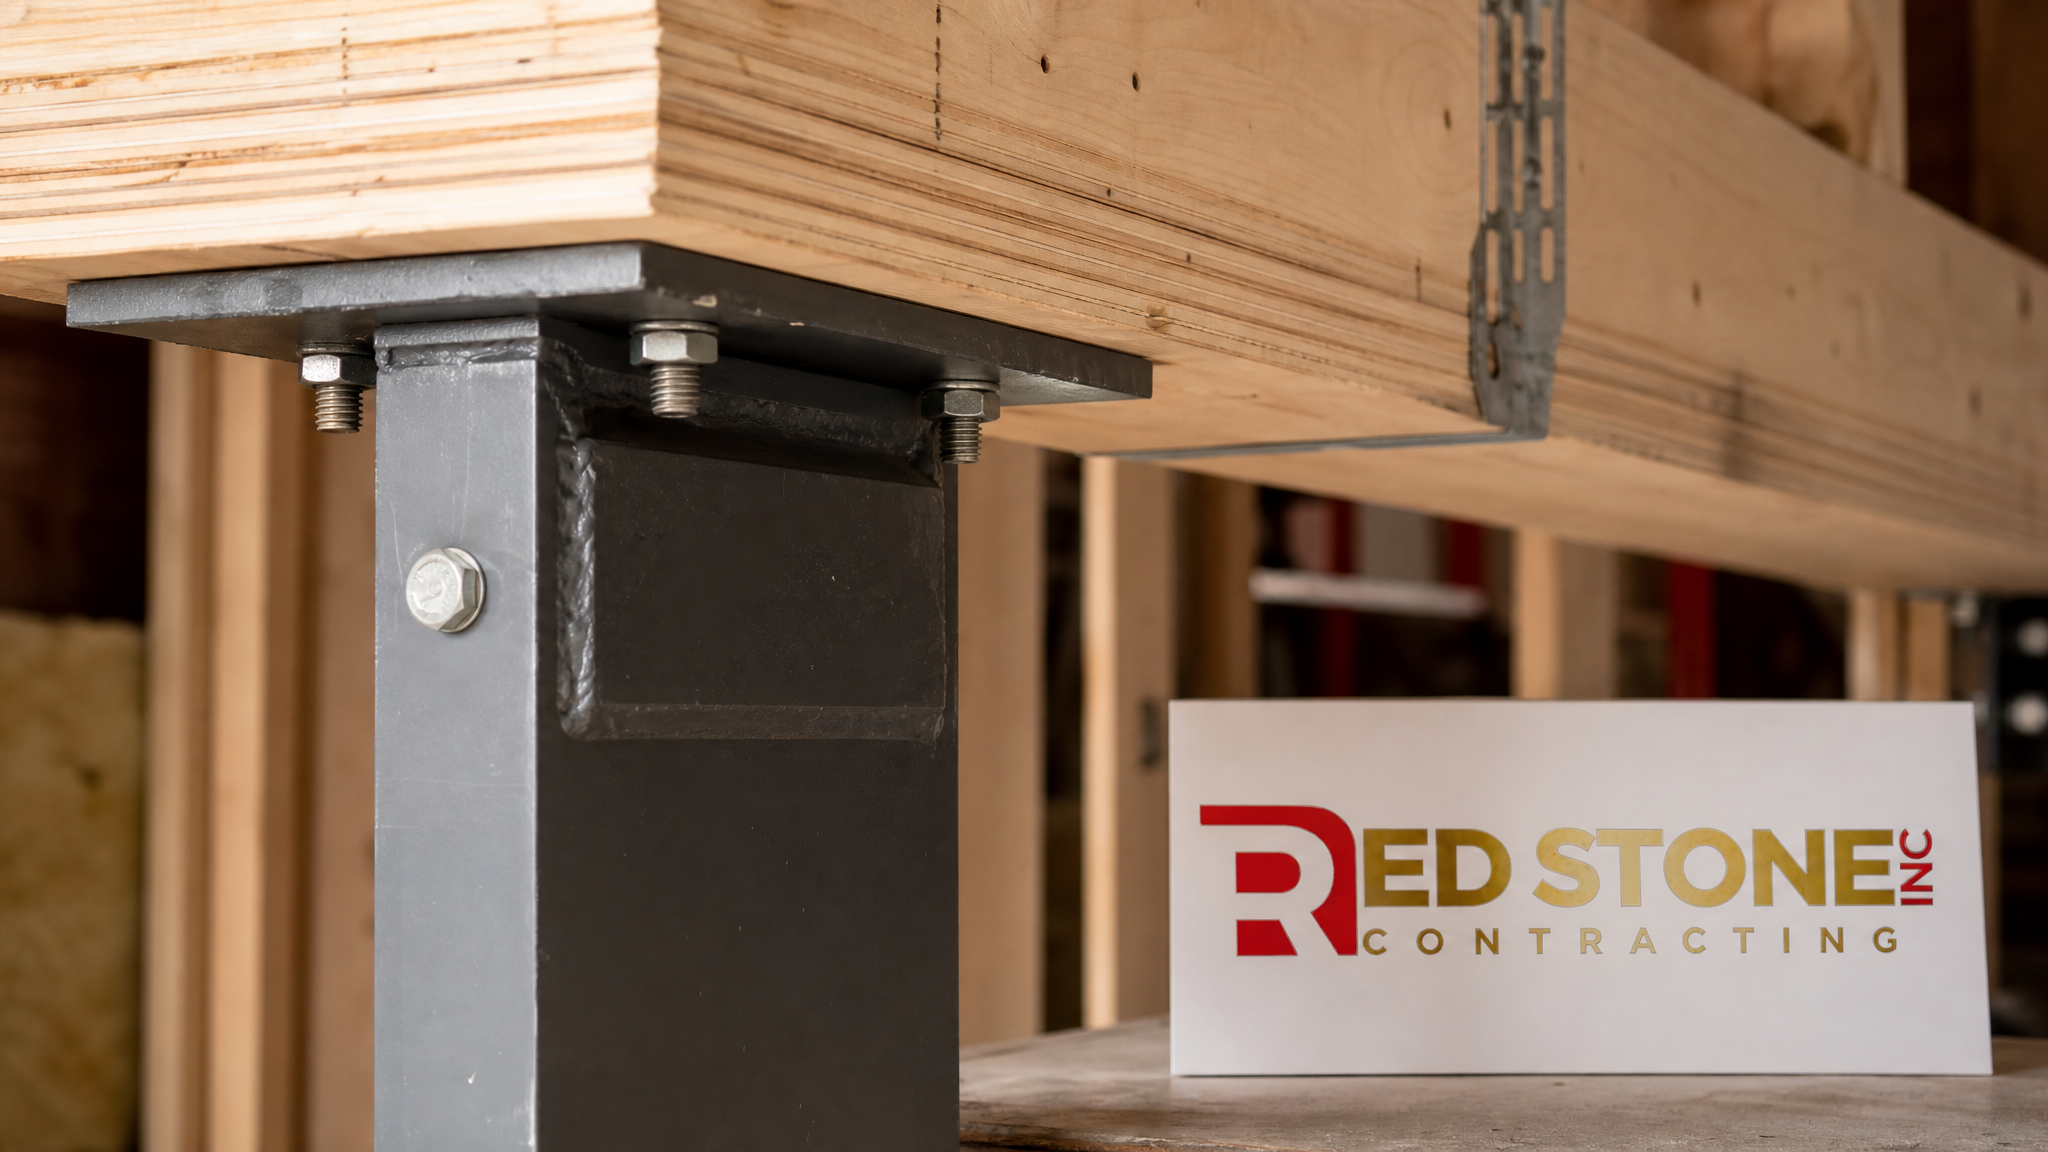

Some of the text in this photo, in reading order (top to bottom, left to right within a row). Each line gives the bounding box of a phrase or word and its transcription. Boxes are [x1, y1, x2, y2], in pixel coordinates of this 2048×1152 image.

[1200, 805, 1895, 956] RED STONE
[1899, 828, 1934, 906] INC
[1363, 927, 1898, 956] CONTRACTING
